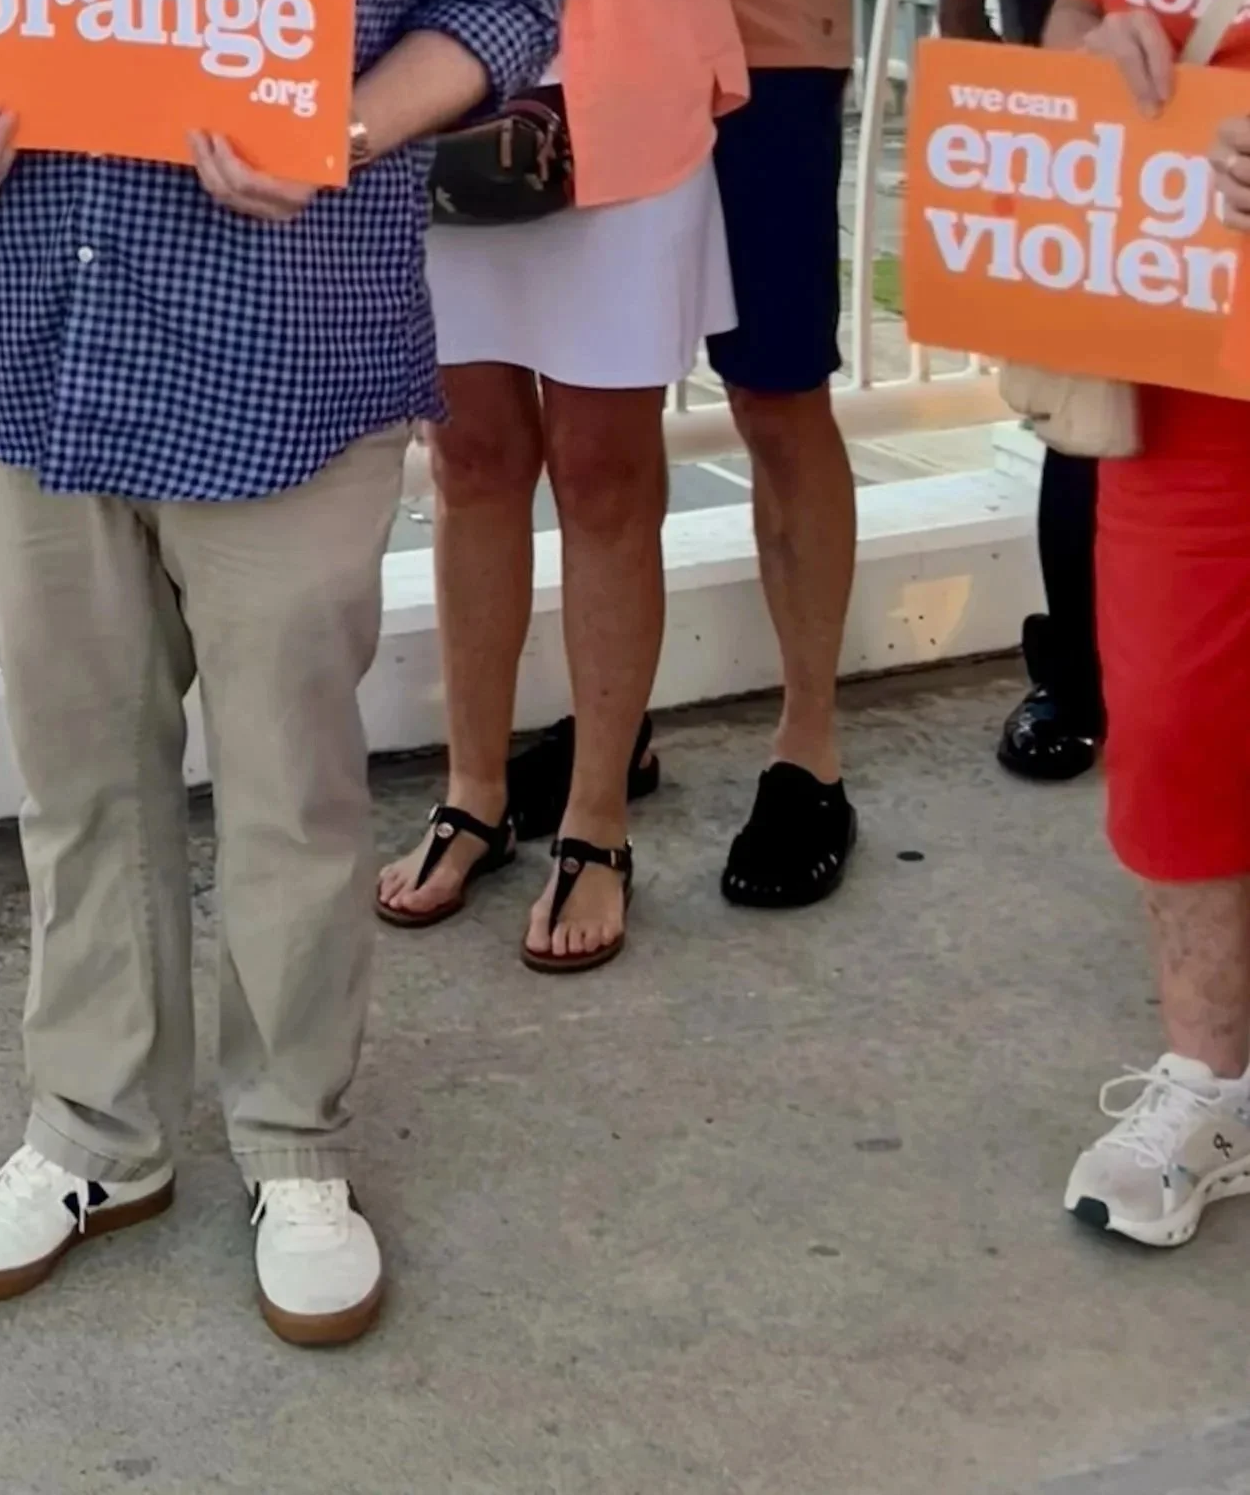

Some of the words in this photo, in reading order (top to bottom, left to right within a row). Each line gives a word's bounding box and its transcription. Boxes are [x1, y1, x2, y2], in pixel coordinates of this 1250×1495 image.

[250, 76, 317, 117] .org
[949, 84, 1004, 112] we
[1006, 90, 1079, 123] can
[926, 121, 1126, 208] end
